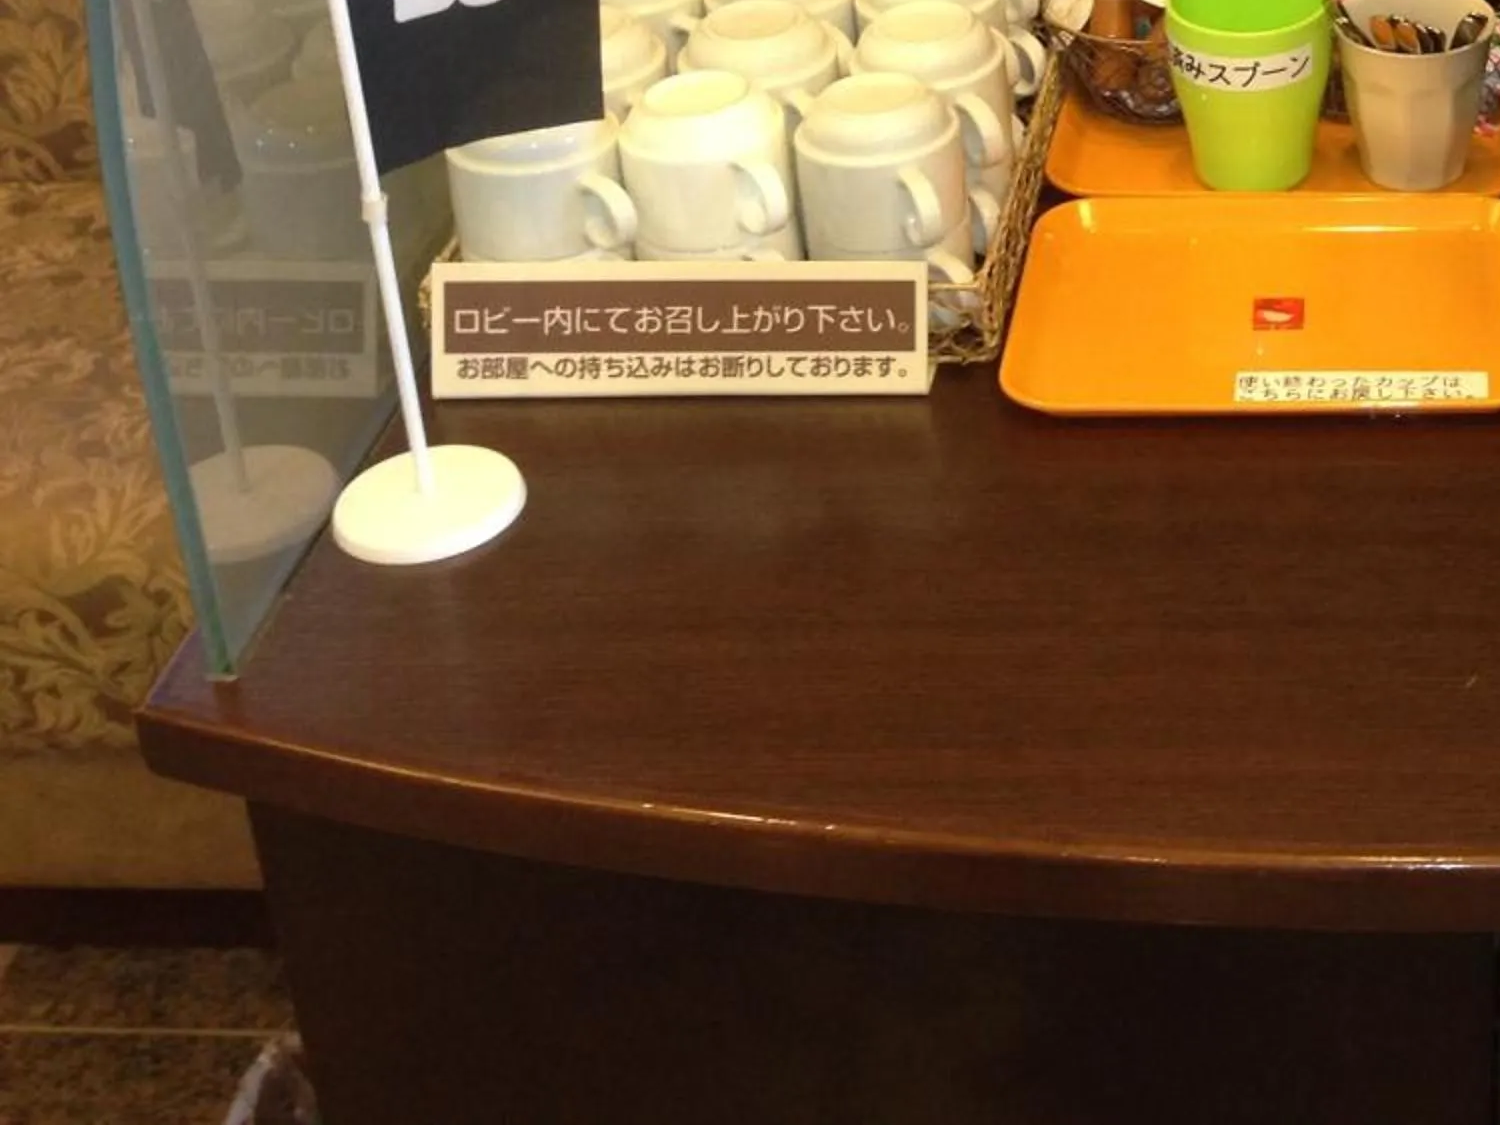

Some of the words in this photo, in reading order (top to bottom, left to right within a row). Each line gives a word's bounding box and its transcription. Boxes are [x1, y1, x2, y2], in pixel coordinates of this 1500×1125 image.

[453, 304, 912, 337] ロビー内にてお召し上がり下さい。
[457, 354, 910, 381] お部屋への持ち込みはお断りしております。
